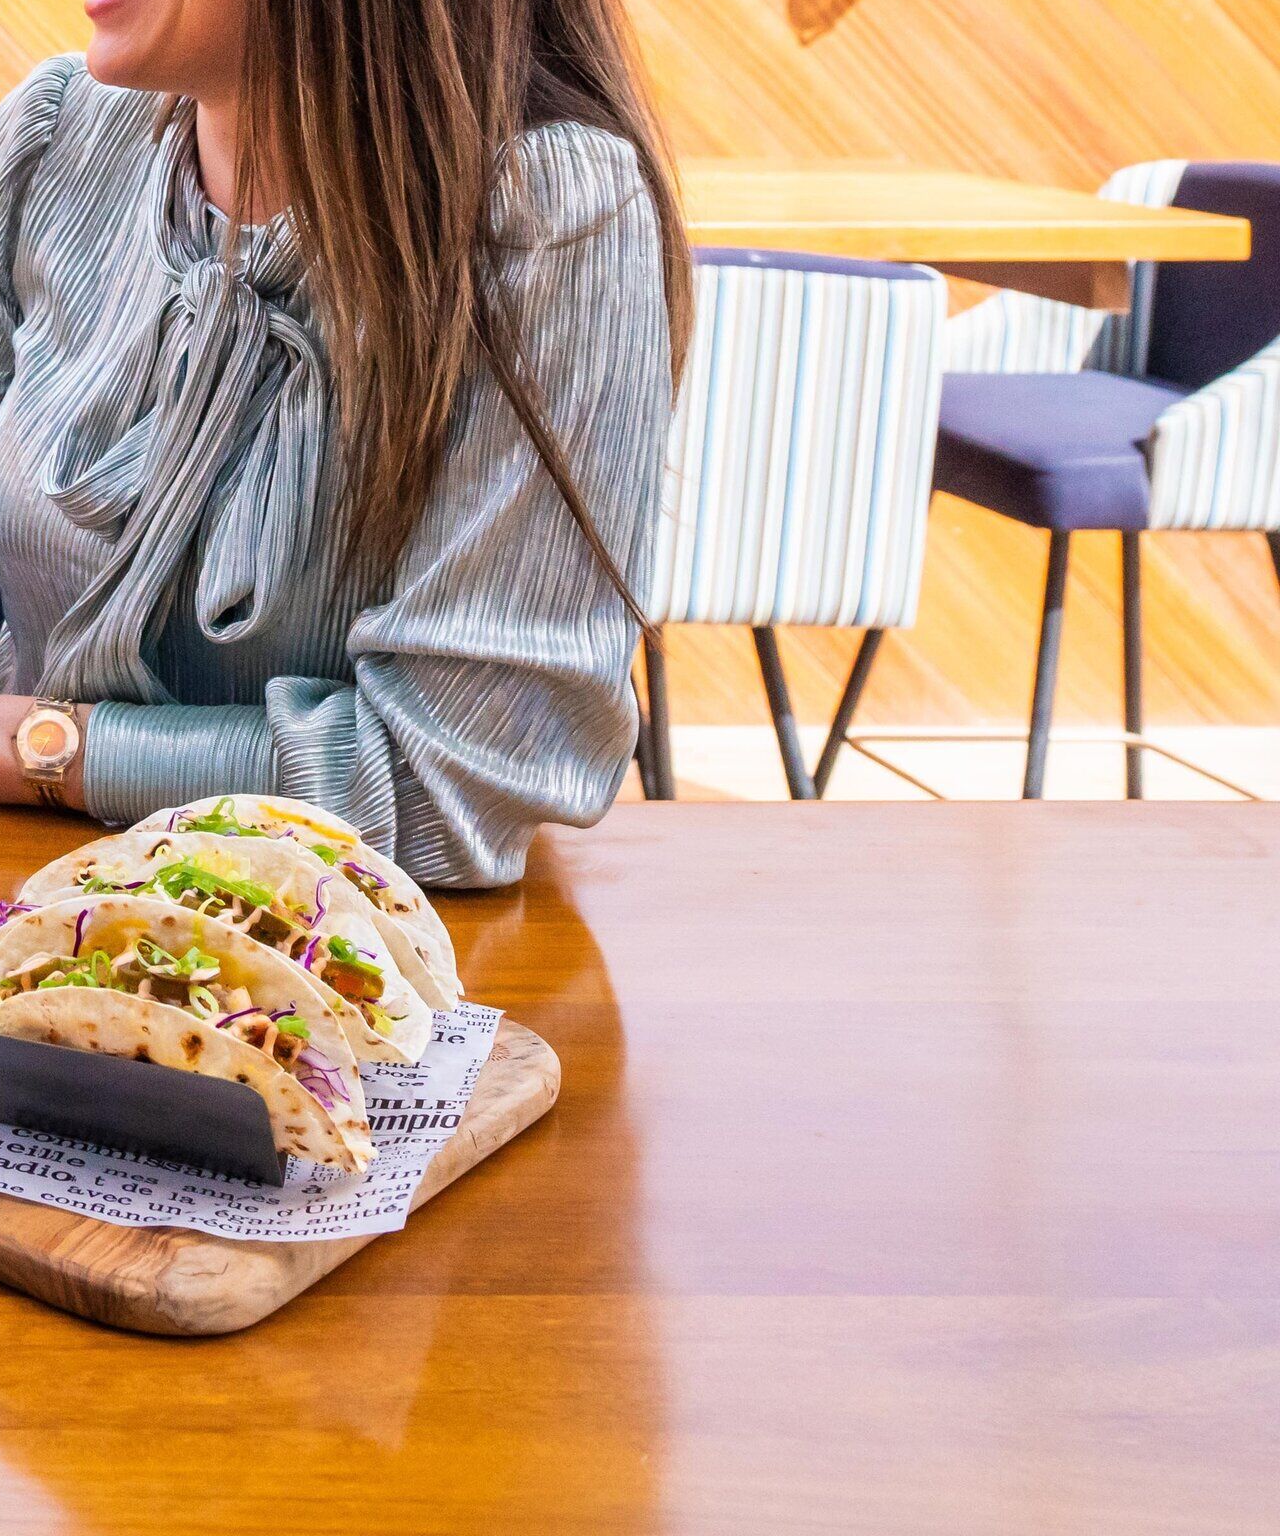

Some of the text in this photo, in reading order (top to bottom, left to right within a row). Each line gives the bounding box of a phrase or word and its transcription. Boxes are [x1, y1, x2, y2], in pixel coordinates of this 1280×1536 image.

[364, 1097, 469, 1110] UILLE
[368, 1111, 462, 1133] ampio
[103, 1167, 159, 1187] mes
[67, 1183, 134, 1207] avec
[148, 1201, 190, 1216] un
[122, 1180, 154, 1197] de
[214, 1201, 260, 1214] ue
